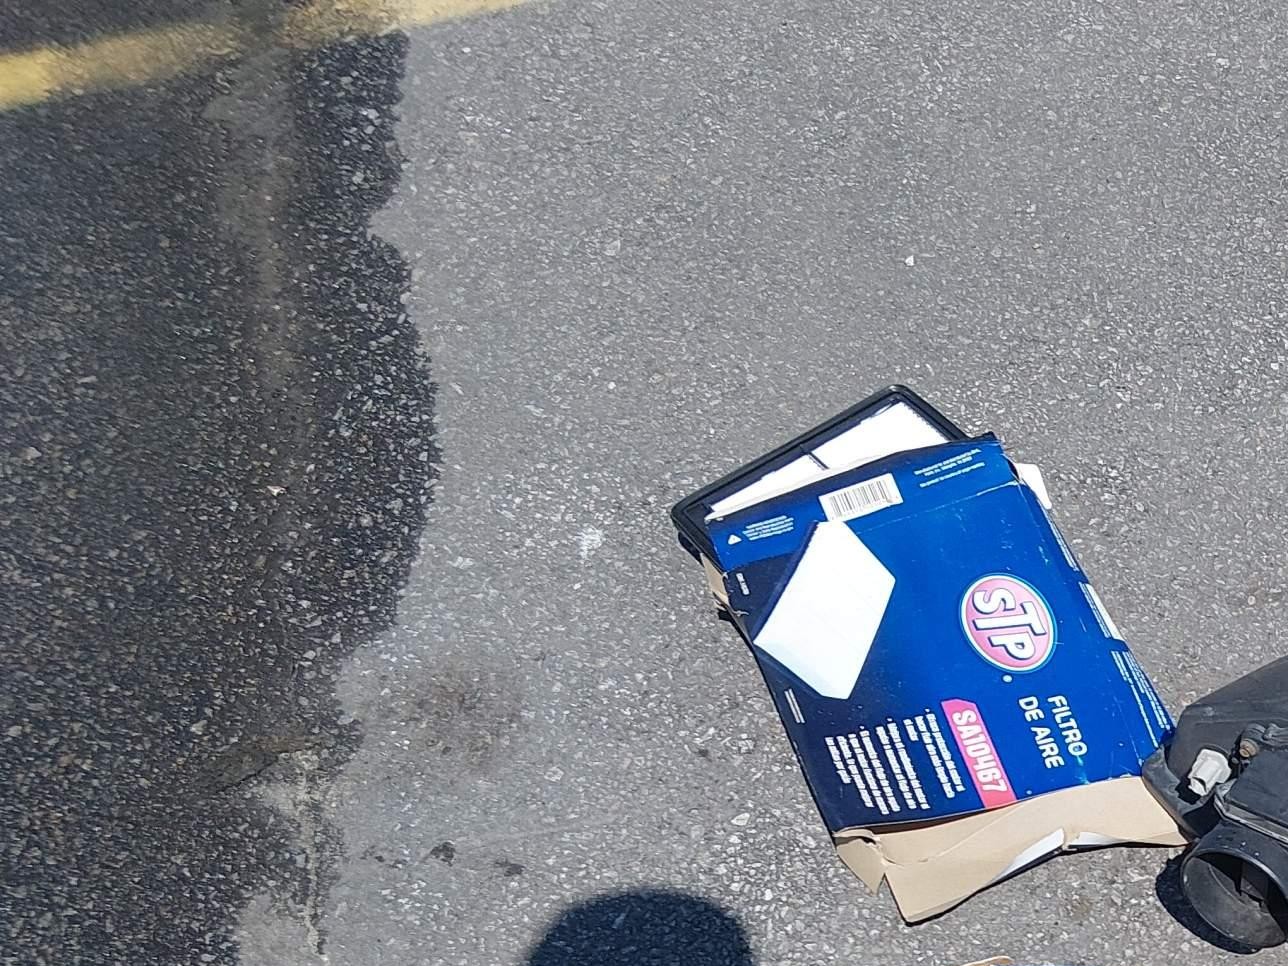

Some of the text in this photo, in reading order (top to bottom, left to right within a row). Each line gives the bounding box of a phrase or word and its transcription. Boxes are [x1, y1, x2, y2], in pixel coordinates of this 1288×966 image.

[972, 586, 1049, 664] STP
[952, 710, 1008, 794] SA10467
[1018, 697, 1065, 770] DE AIRE
[1047, 694, 1087, 759] FILTRO
